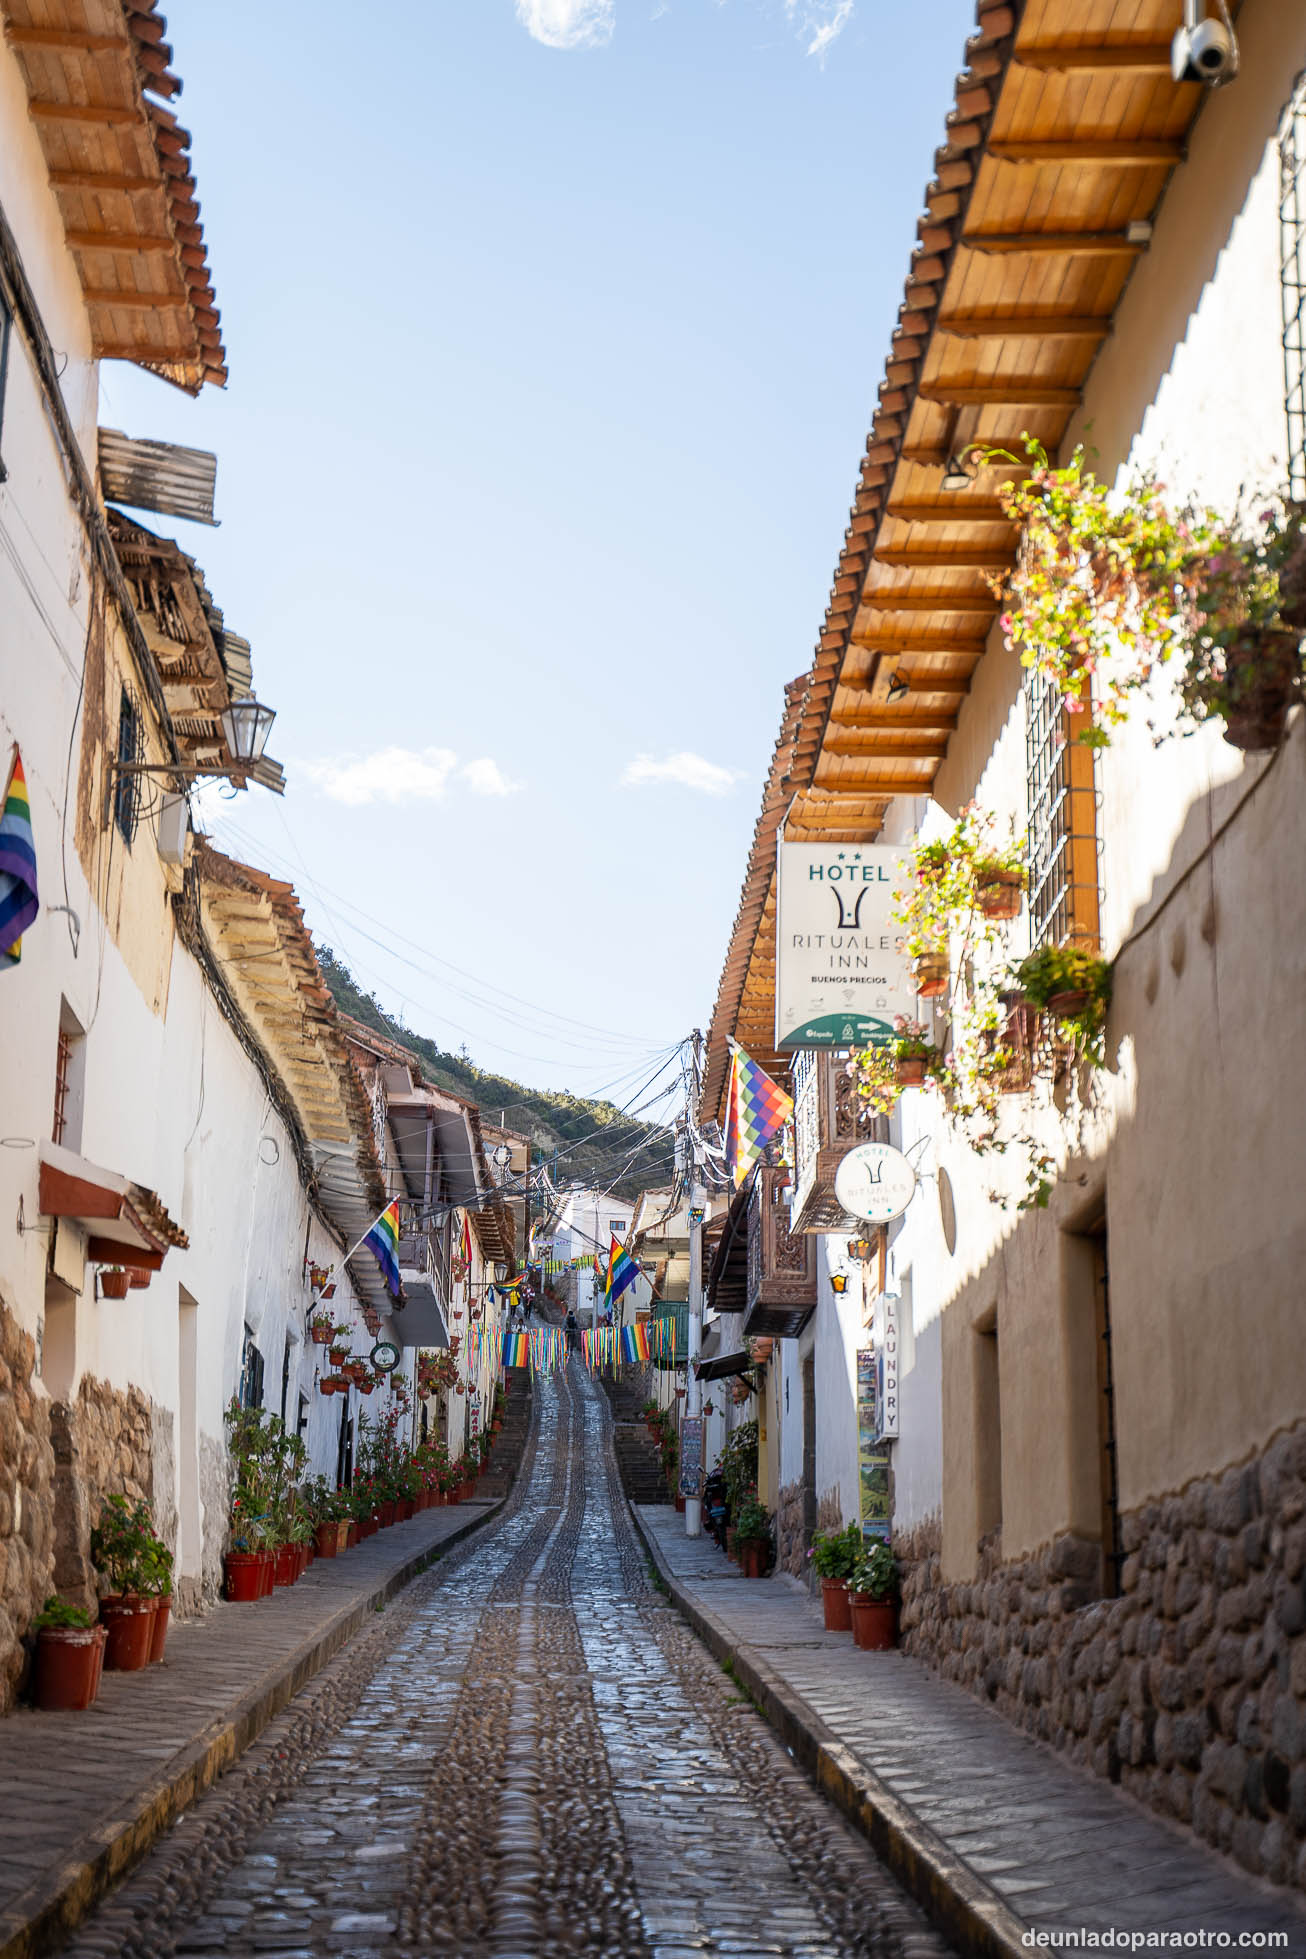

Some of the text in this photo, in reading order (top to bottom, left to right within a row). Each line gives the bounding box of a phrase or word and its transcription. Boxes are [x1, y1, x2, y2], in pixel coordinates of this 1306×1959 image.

[809, 865, 890, 882] HOTEL
[830, 955, 869, 968] INN
[811, 976, 887, 984] BUENOS PRECIOS
[856, 1148, 889, 1160] HOTEL
[886, 1305, 897, 1427] LAUNDRY
